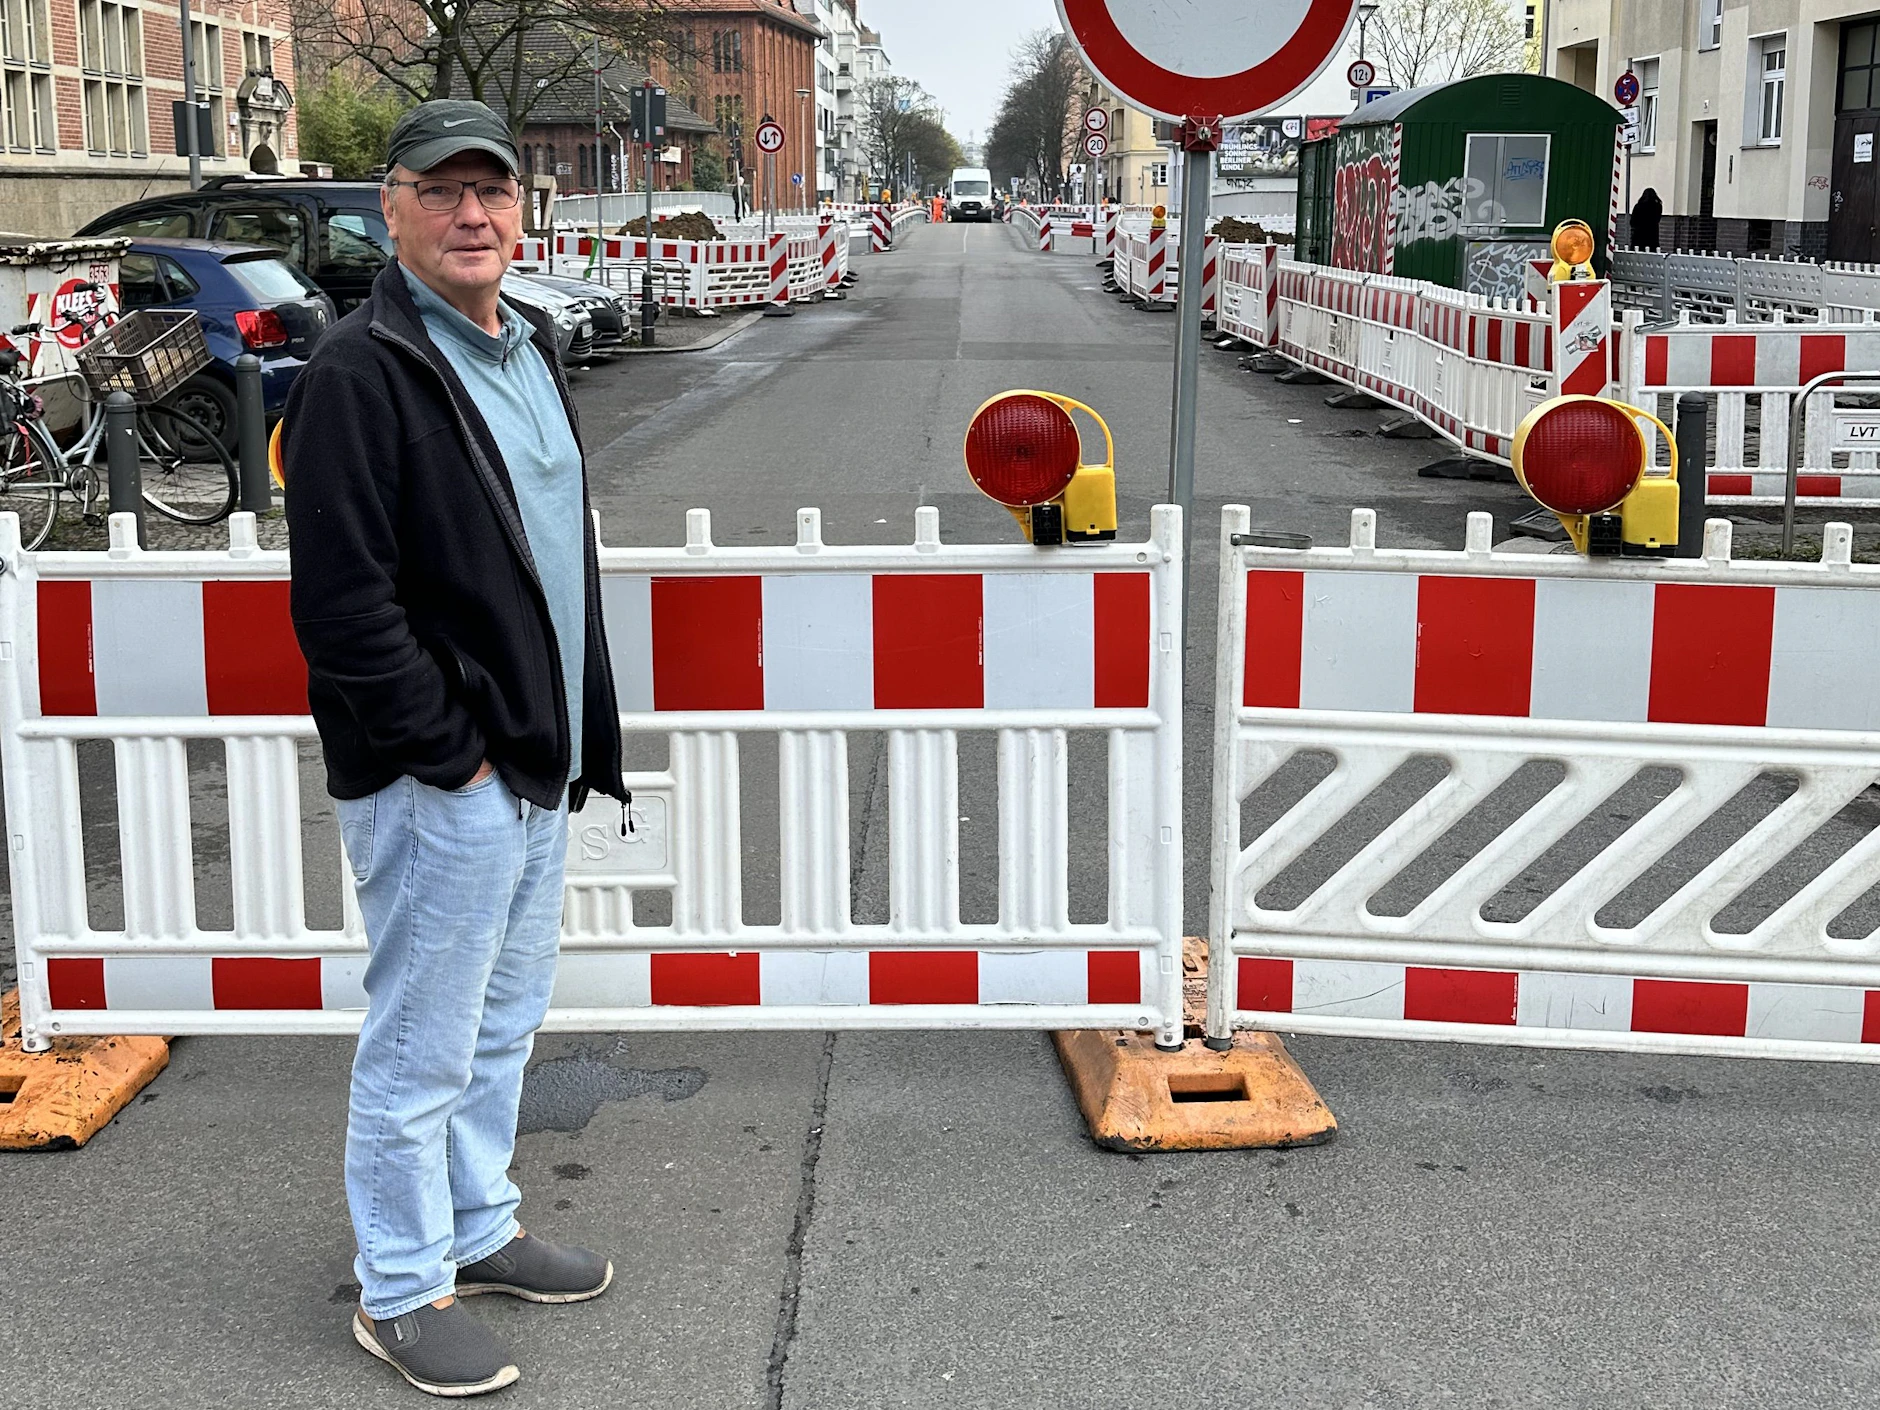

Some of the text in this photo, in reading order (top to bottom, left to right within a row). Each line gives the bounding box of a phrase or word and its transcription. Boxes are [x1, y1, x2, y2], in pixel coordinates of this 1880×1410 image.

[1090, 139, 1103, 151] 20
[1220, 156, 1252, 164] BERLINER
[89, 265, 110, 283] 3563
[1850, 426, 1879, 438] LVT
